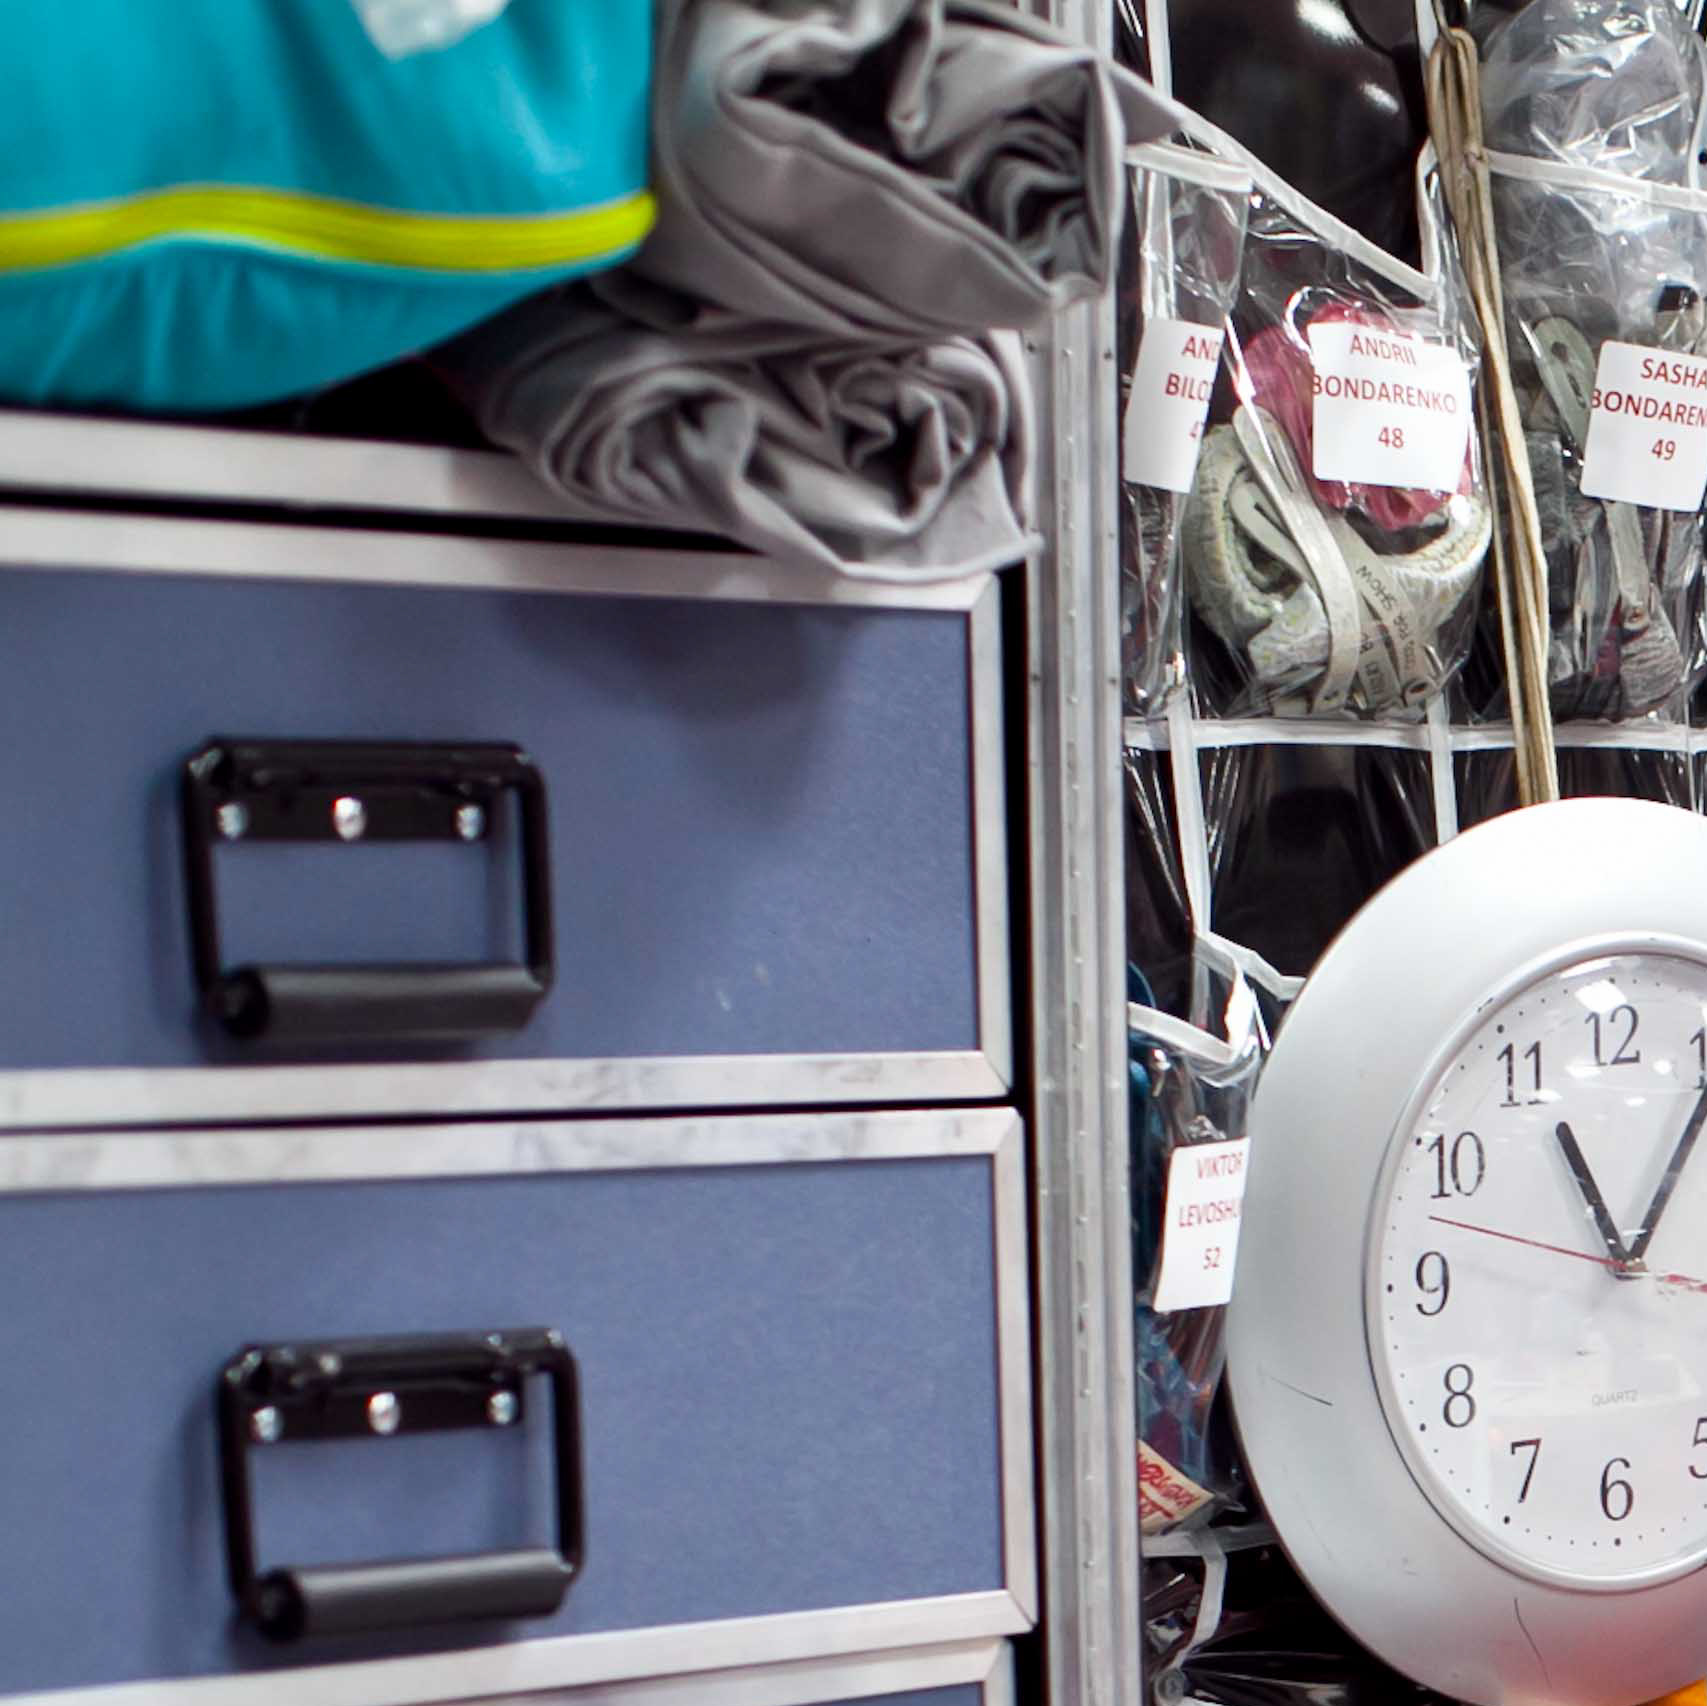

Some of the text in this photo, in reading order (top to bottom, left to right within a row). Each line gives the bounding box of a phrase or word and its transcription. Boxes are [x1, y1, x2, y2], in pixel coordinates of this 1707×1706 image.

[1350, 334, 1416, 366] ANDRII
[1312, 374, 1457, 414] BONDARENKO
[1378, 425, 1405, 449] 48
[1651, 439, 1677, 461] 49
[1584, 1004, 1642, 1067] 12
[1496, 1041, 1549, 1108] 11
[1427, 1130, 1486, 1200] 10
[1203, 1246, 1222, 1271] 52
[1414, 1250, 1451, 1317] 9
[1442, 1363, 1477, 1429] 8
[1591, 1388, 1639, 1407] QUARTZ
[1509, 1437, 1543, 1504] 7
[1599, 1456, 1635, 1522] 6
